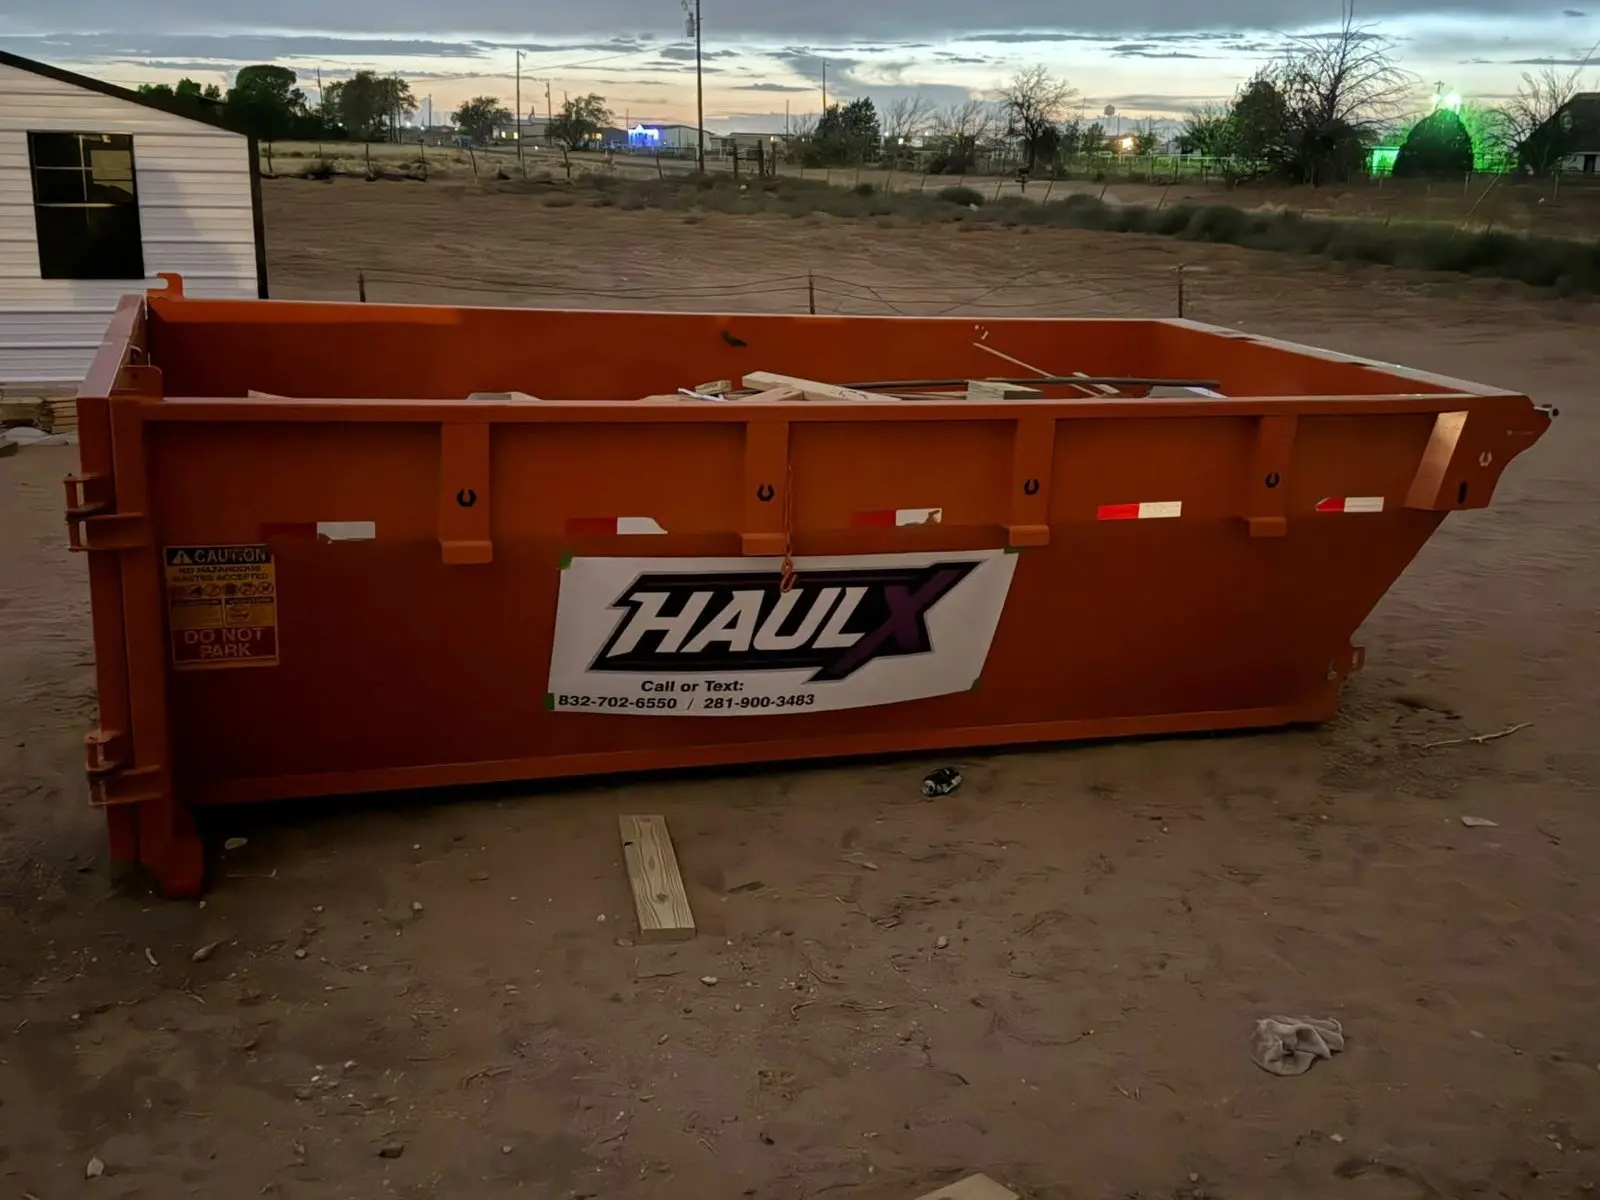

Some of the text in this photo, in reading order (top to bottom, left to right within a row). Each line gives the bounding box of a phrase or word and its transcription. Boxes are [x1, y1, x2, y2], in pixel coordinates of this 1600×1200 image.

[184, 627, 267, 644] DO NOT
[199, 643, 252, 659] PARK
[641, 680, 744, 693] Call or Text:
[558, 694, 815, 710] 832-702-6550 / 281-900-3483
